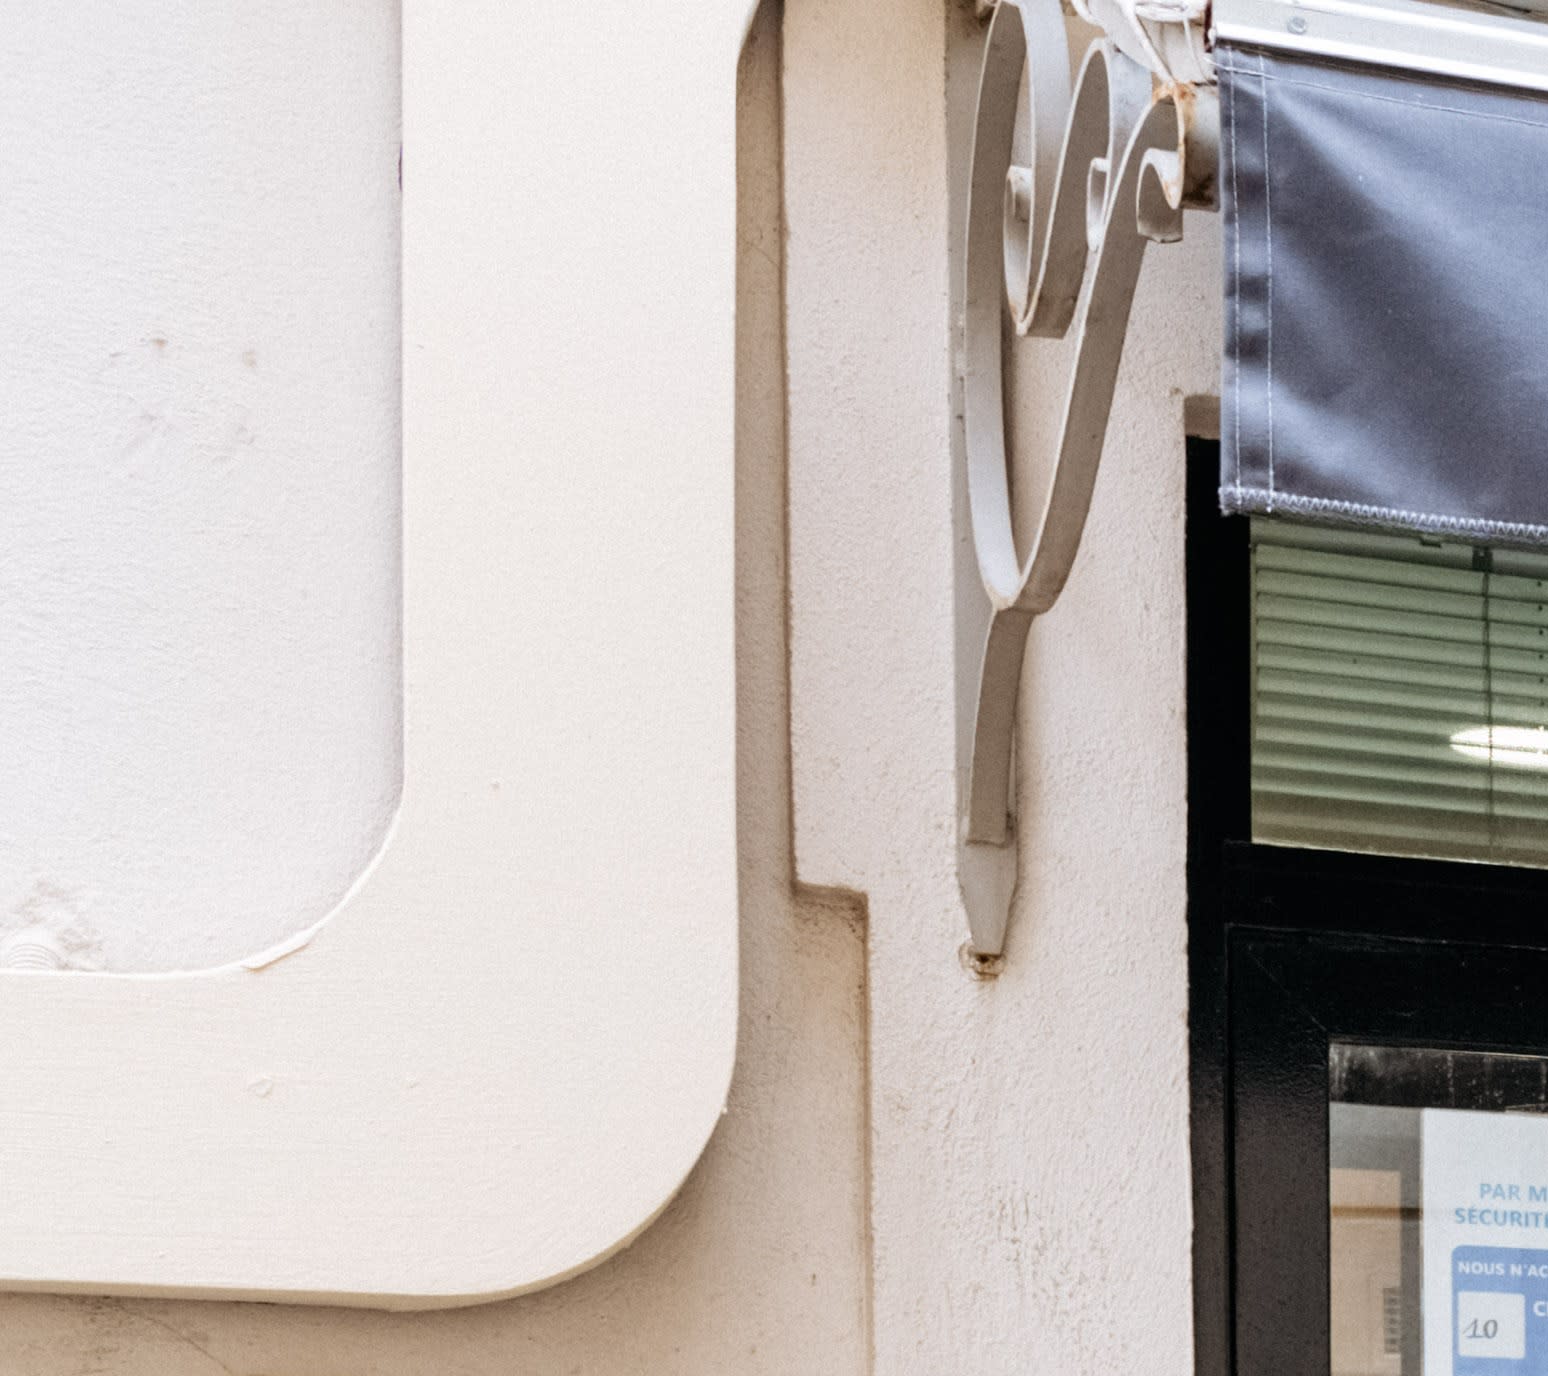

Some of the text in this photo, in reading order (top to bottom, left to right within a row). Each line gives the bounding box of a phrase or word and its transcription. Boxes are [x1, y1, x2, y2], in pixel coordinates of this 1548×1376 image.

[1479, 1183, 1521, 1200] PAR
[1458, 1261, 1504, 1276] NOUS
[1463, 1318, 1498, 1339] 10
